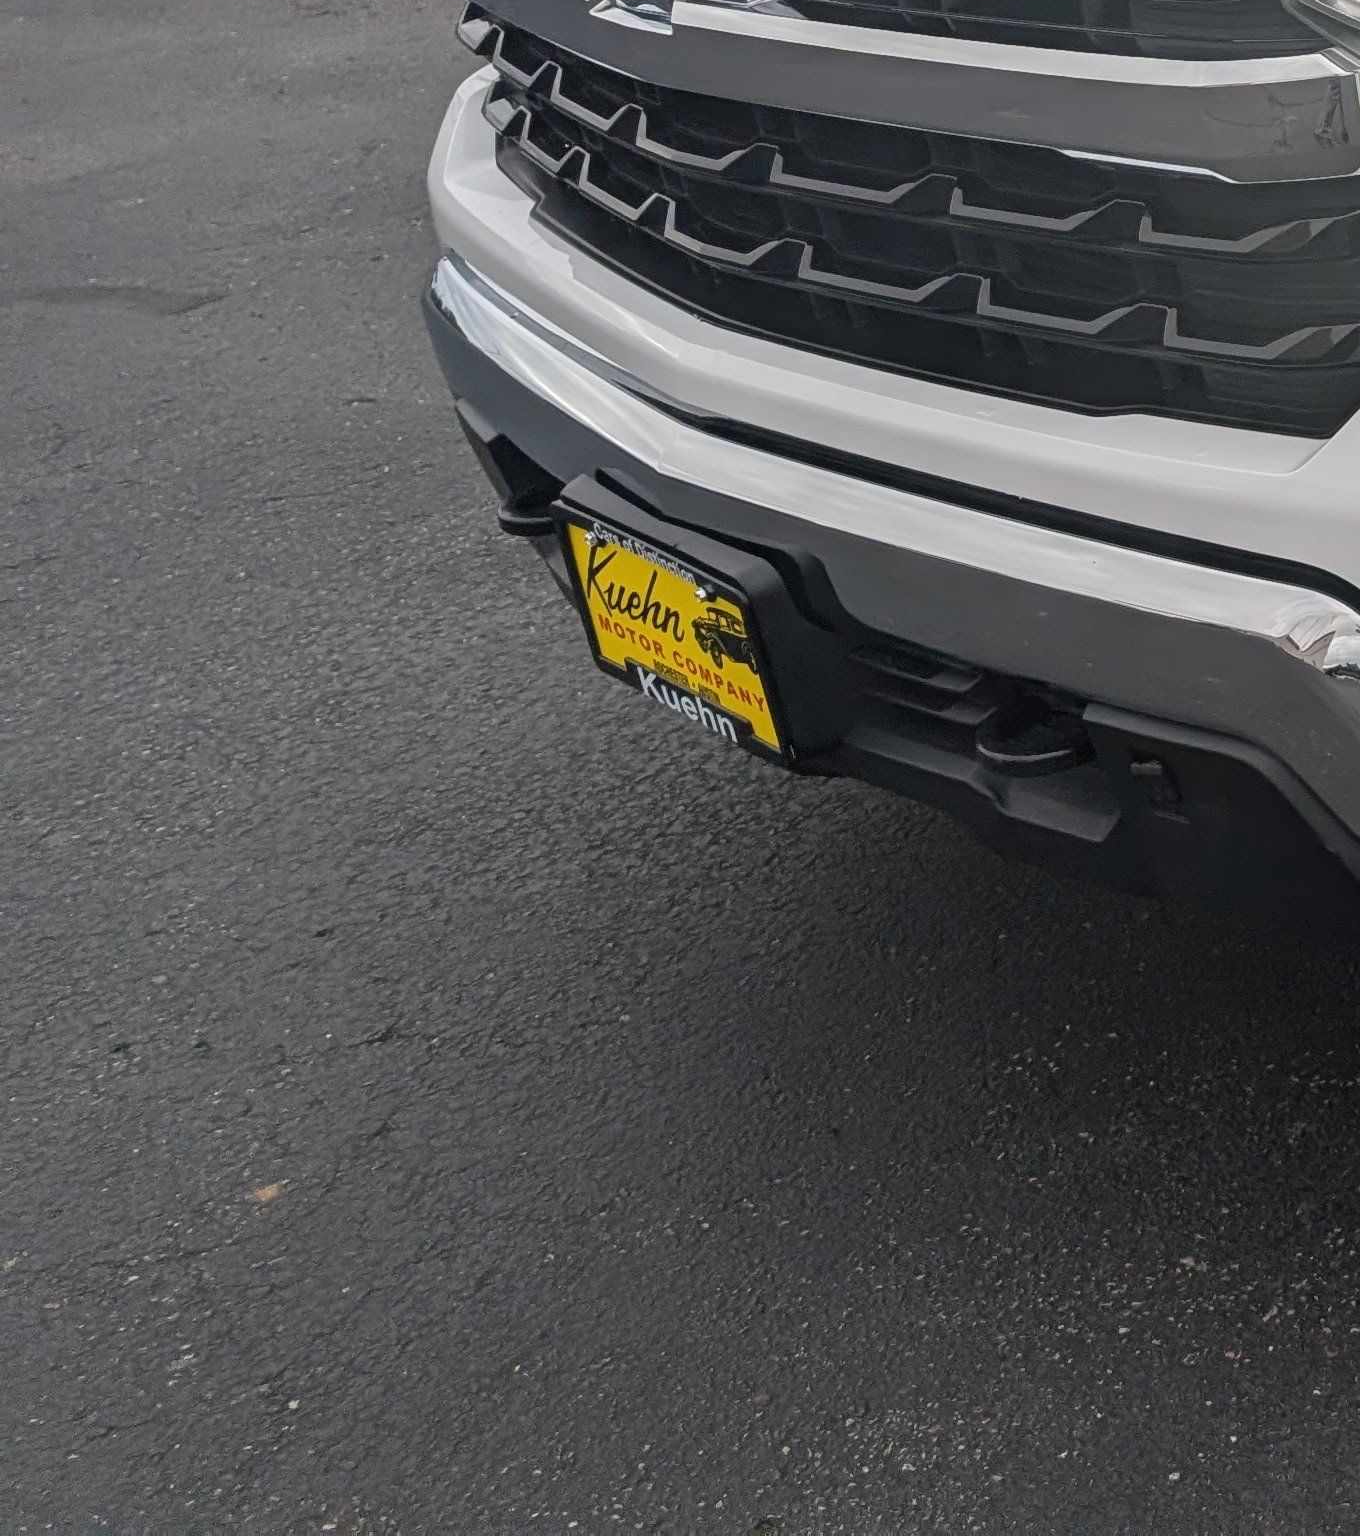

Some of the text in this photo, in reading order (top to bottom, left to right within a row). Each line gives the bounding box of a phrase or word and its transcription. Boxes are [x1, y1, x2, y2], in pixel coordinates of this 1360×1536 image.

[587, 545, 685, 642] Kuehn
[598, 613, 764, 712] MOTOR COMPANY
[636, 666, 738, 742] Kuehn
